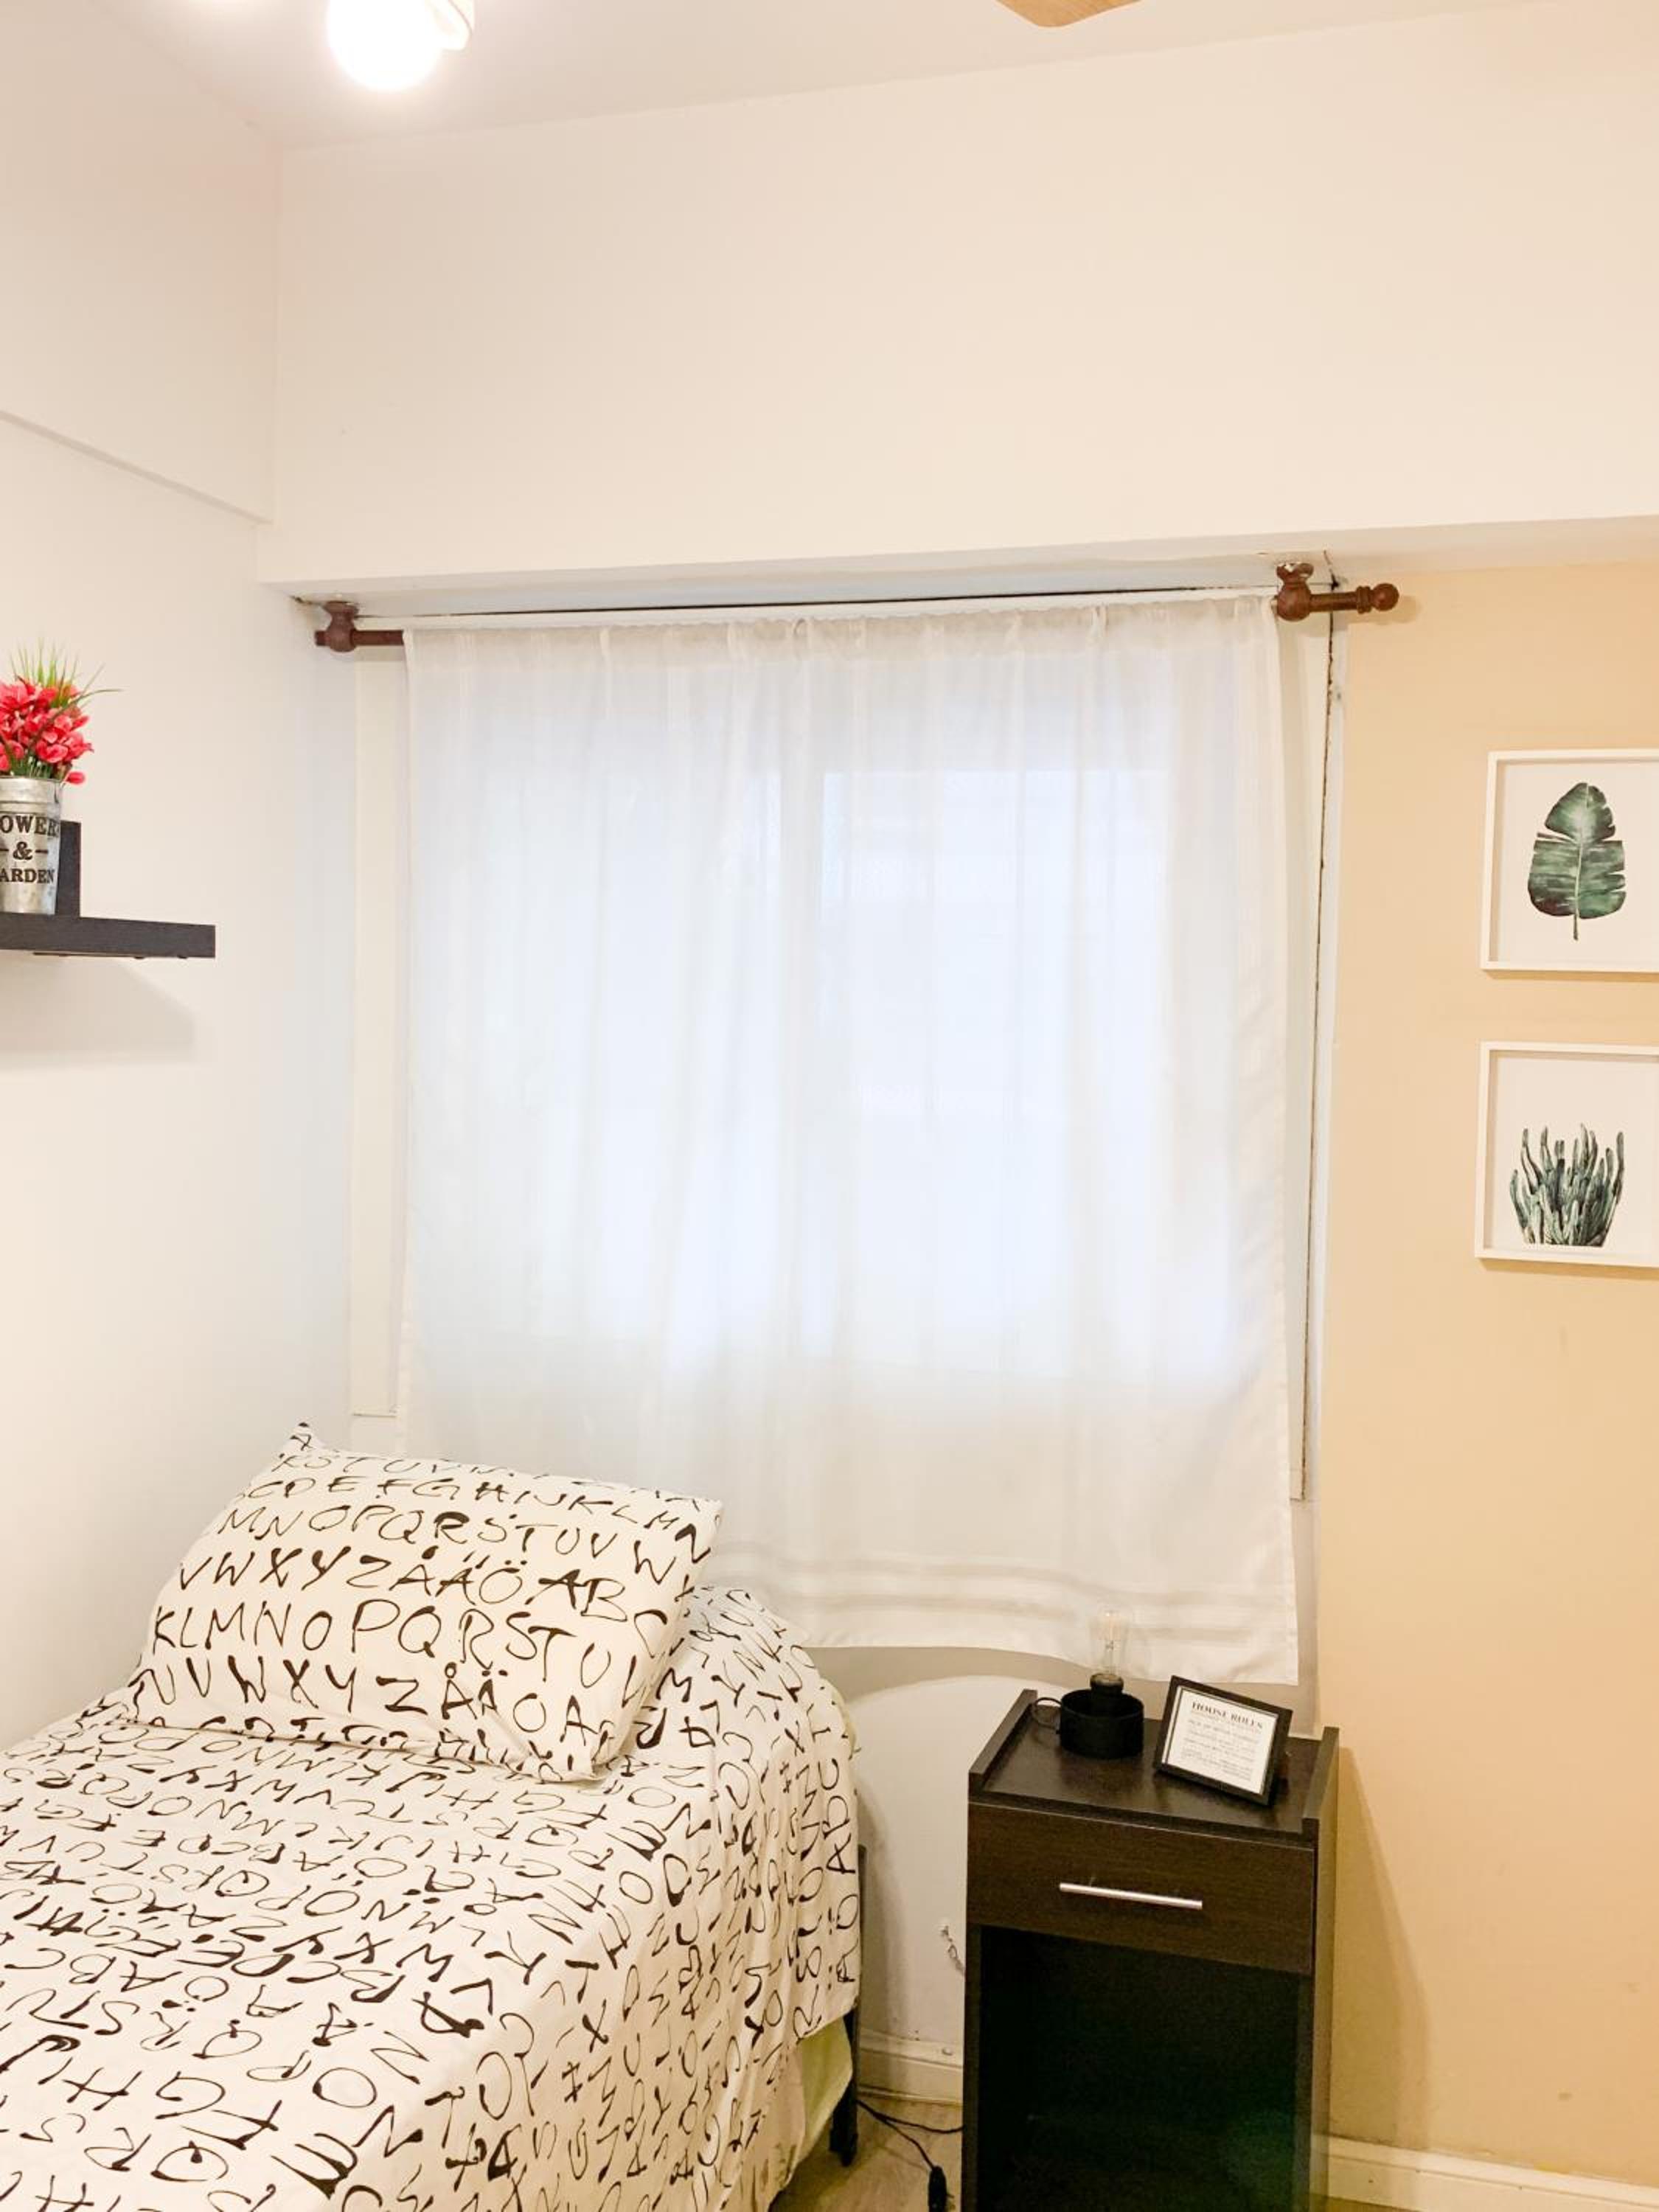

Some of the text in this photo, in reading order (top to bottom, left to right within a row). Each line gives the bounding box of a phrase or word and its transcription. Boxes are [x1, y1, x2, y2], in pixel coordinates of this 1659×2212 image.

[13, 841, 32, 860] &
[1192, 1701, 1264, 1729] HOUSE RULES
